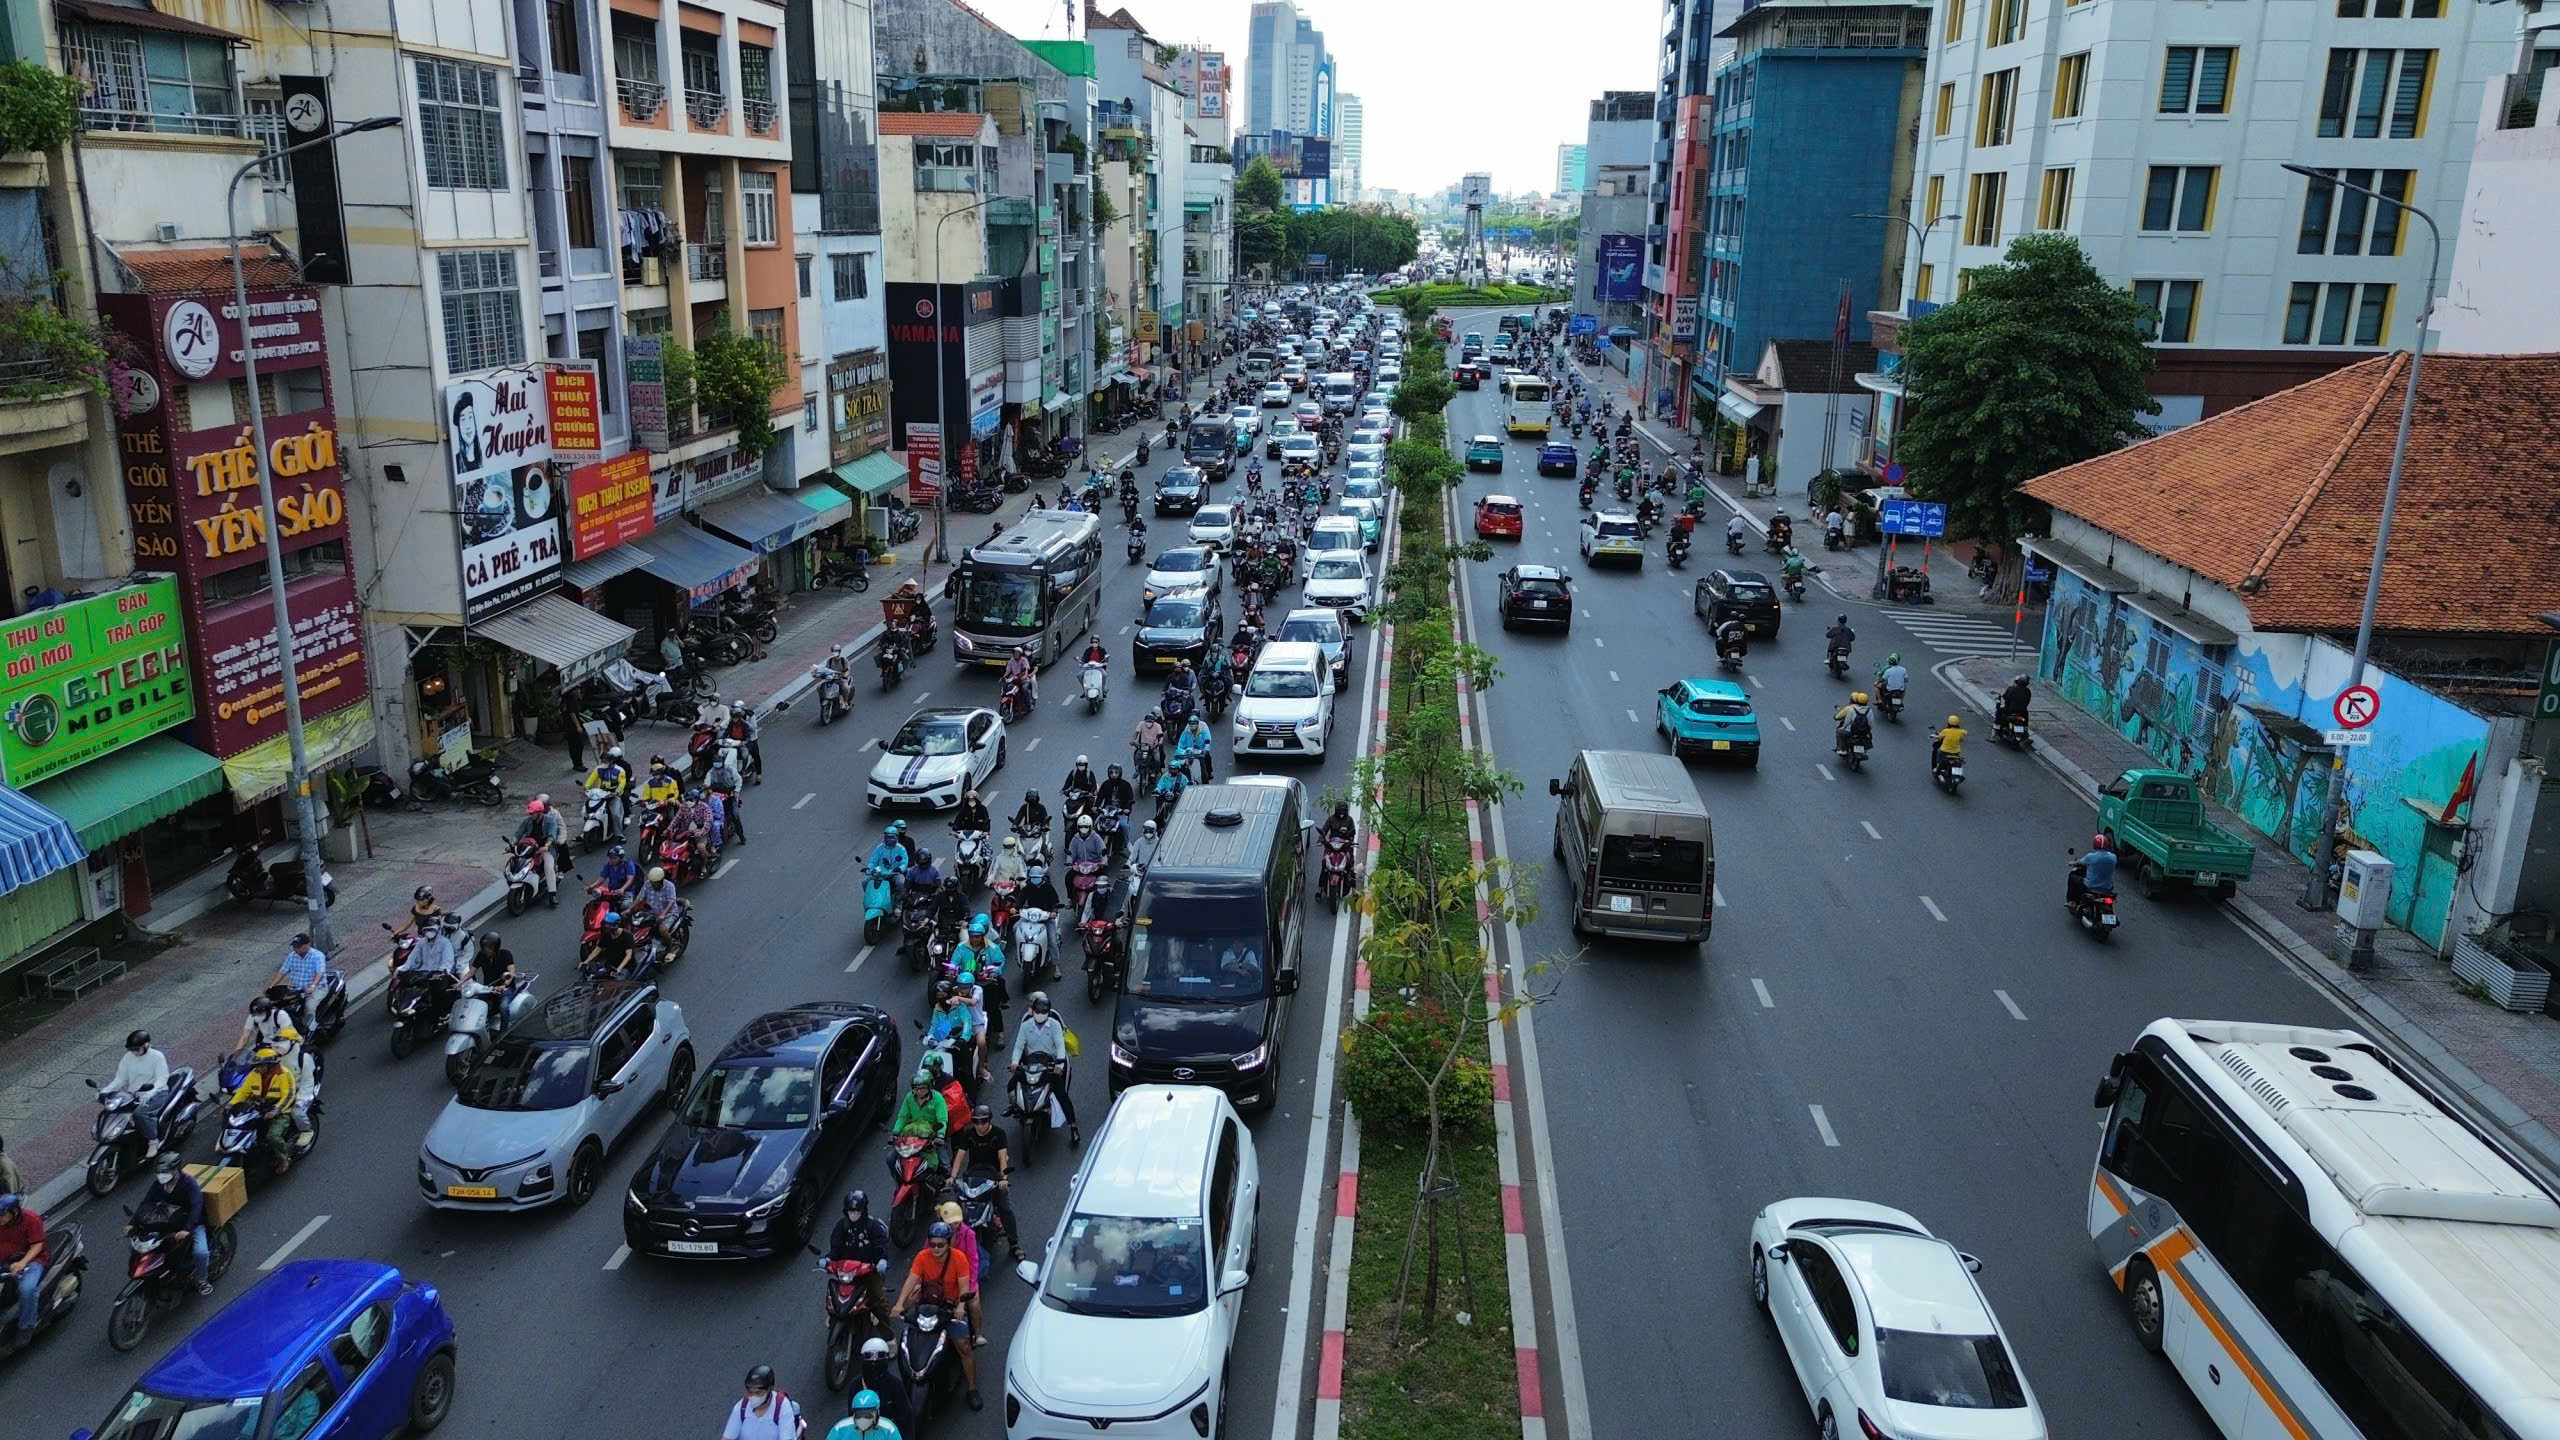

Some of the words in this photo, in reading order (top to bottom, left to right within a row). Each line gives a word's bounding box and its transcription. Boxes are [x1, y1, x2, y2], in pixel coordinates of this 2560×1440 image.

[1204, 96, 1218, 106] 14
[222, 301, 252, 319] CÔG
[555, 376, 585, 388] DỊCH
[490, 380, 528, 417] Mai
[552, 391, 591, 404] THUẬT
[556, 405, 590, 417] CÔNG
[123, 425, 163, 454] THẾ
[482, 414, 547, 459] Huyền
[554, 420, 595, 433] CHỨNG
[557, 437, 595, 448] ASEAN
[186, 426, 260, 496] THẾ
[270, 421, 337, 477] GIỚI
[128, 463, 169, 487] GIỚI
[131, 496, 172, 524] YẾN
[576, 492, 599, 518] DỊCH
[598, 481, 623, 508] THUẬT
[623, 475, 650, 499] ASEAN
[194, 492, 268, 558] YẾN
[277, 483, 342, 537] SÀO
[137, 532, 177, 557] SÀO
[467, 553, 489, 587] CÀ
[492, 541, 521, 578] PHÊ
[529, 528, 559, 563] TRÀ
[117, 591, 149, 613] BÁN
[6, 625, 38, 649] THU
[44, 615, 66, 637] CŨ
[106, 618, 134, 645] TRẢ
[138, 612, 166, 635] GÓP
[6, 651, 37, 679] ĐỔI
[41, 643, 74, 668] MỚI
[261, 658, 282, 677] PHẨ
[64, 642, 184, 709] G.TECH
[68, 678, 186, 735] MOBILE
